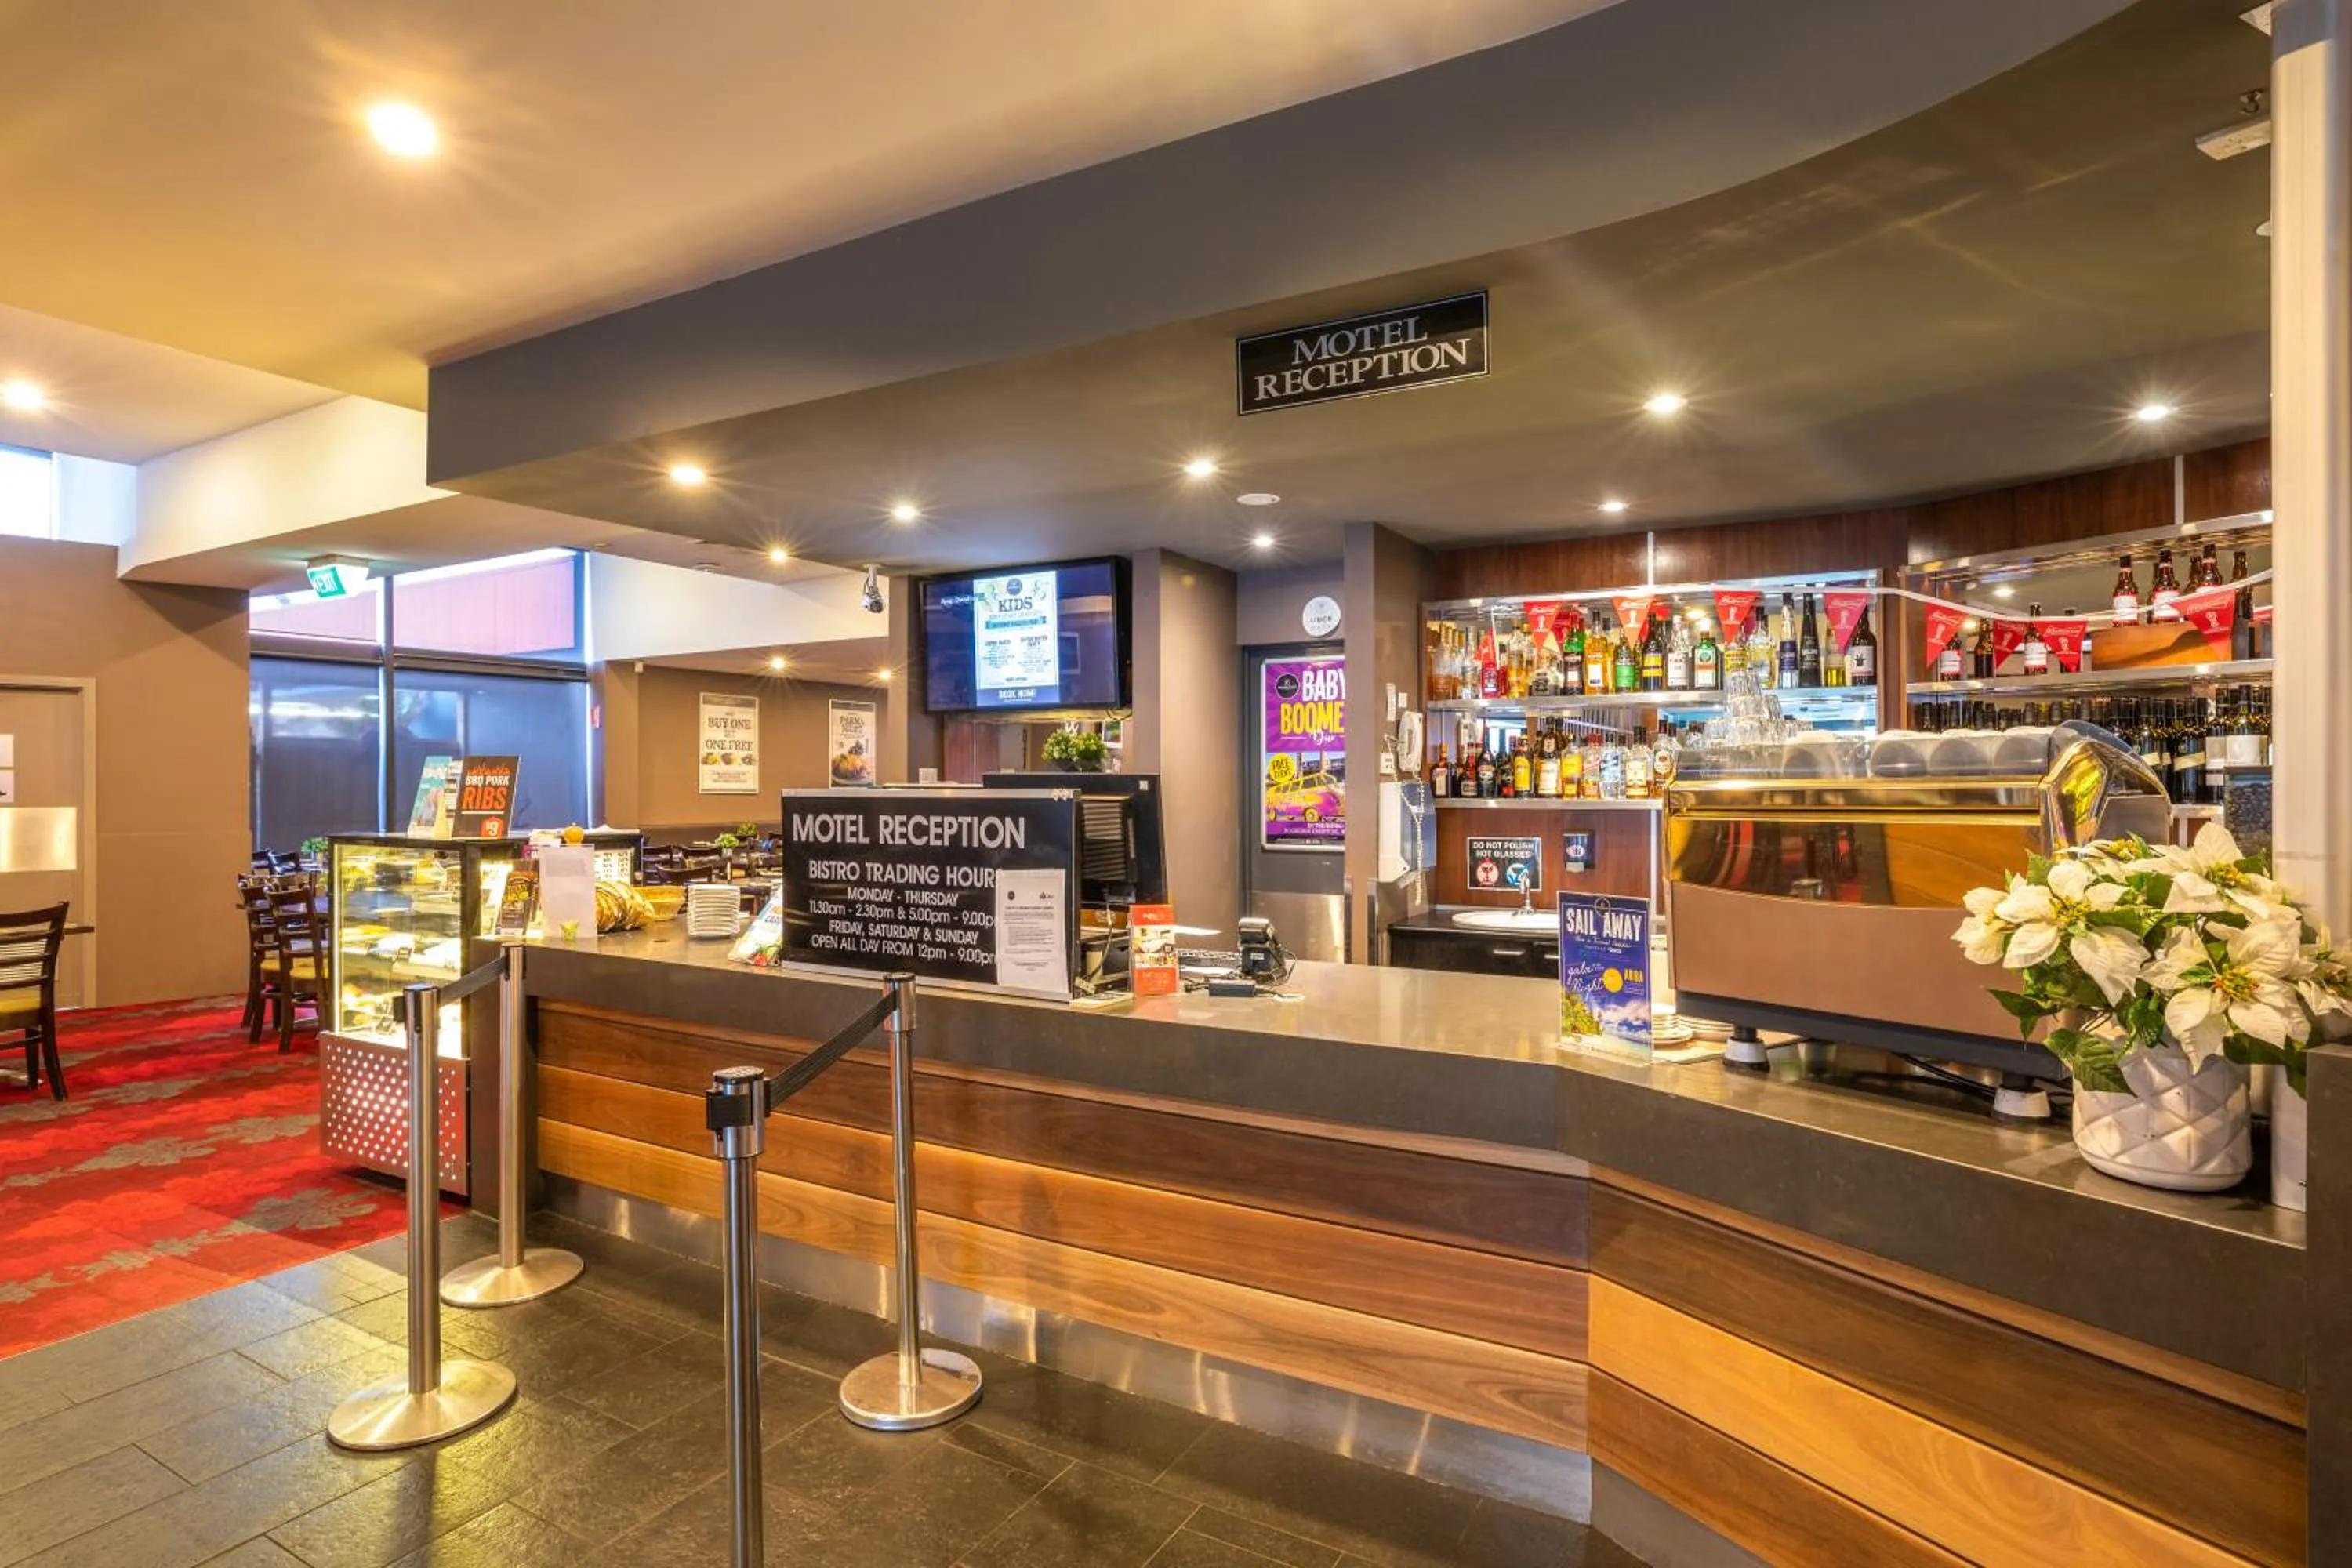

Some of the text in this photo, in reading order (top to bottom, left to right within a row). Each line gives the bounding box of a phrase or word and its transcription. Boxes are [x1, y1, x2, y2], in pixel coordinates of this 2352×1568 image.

[1292, 316, 1428, 365] MOTEL
[1254, 338, 1471, 401] RECEPTION
[998, 597, 1033, 612] KIDS
[708, 717, 752, 730] BUY ONE
[706, 739, 753, 751] ONE FREE
[465, 775, 510, 787] BBQ PORK
[462, 786, 508, 810] RIBS
[792, 813, 1025, 849] MOTEL RECEPTION
[1475, 849, 1492, 858] HOT
[1503, 841, 1534, 851] POLISH
[808, 860, 1001, 888] BISTRO TRADING HOUR
[848, 887, 894, 902] MONDAY
[905, 891, 959, 907] THURSDAY
[809, 899, 846, 915] 11.30am
[855, 903, 894, 920] 2.30pm
[898, 906, 906, 920] &
[909, 907, 950, 924] 5.00pm
[962, 910, 996, 928] 9.00p
[1566, 908, 1597, 935] SAIL
[1602, 912, 1642, 942] AWAY
[829, 920, 978, 945] FRIDAY, SATURDAY & SUNDAY
[811, 934, 837, 949] OPEN
[840, 937, 857, 951] ALL
[860, 938, 880, 953] DAY
[882, 940, 913, 956] FROM
[917, 943, 946, 960] 12pm
